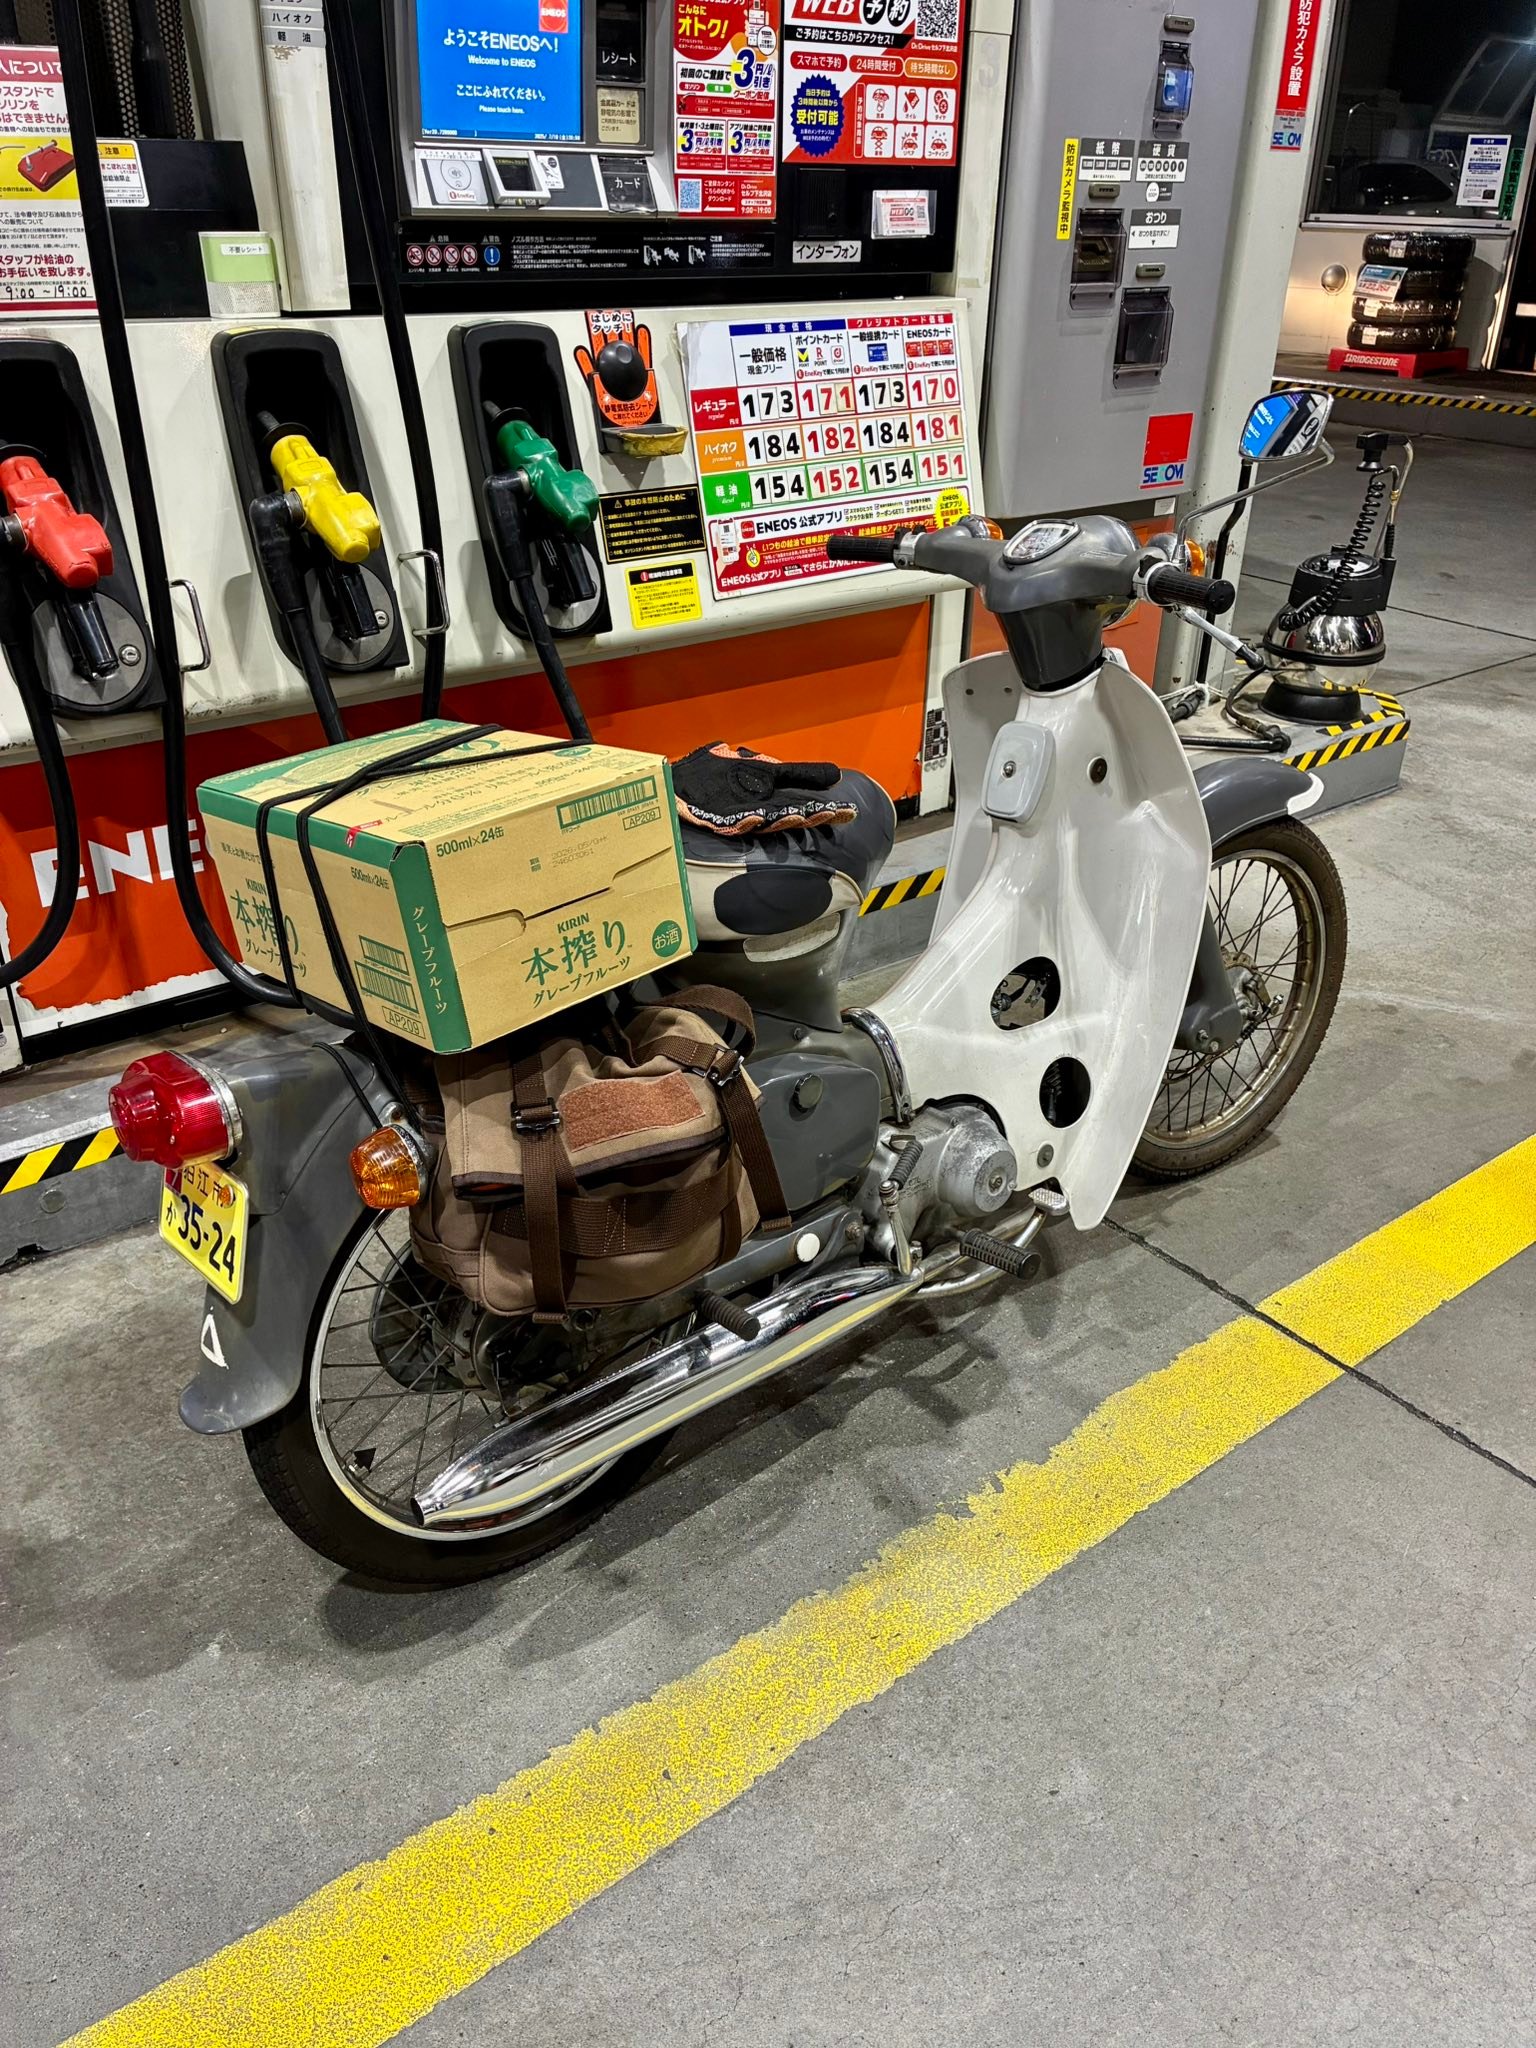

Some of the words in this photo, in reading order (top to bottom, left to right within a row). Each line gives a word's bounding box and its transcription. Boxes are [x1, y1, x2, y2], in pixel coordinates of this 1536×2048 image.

[272, 12, 312, 23] ハイオク
[678, 4, 707, 16] こんなに
[678, 16, 728, 39] オトク!
[795, 27, 895, 46] ご予約はこちらからアクセス!
[443, 28, 559, 53] ようこそENEOSへ!
[1288, 0, 1312, 97] 防犯カメラ設置
[468, 54, 500, 66] Welcome
[501, 57, 509, 67] to
[510, 57, 537, 68] ENEOS
[602, 50, 637, 67] レシート
[797, 55, 842, 69] スマホで予約
[856, 58, 896, 72] 24時間受付
[734, 48, 755, 88] 3
[910, 62, 951, 75] 待ち時間なし
[456, 84, 546, 102] ここにふれてください。
[796, 109, 839, 126] 受付可能
[1273, 132, 1302, 146] SECOM
[1095, 141, 1121, 156] 紙幣
[1152, 143, 1176, 158] 硬貨
[614, 176, 641, 190] カード
[1060, 143, 1076, 234] 防犯カメラ監視中
[1145, 211, 1167, 224] おつり
[796, 244, 859, 260] インターフォン
[591, 312, 632, 323] はじめに
[857, 314, 944, 328] クレジットカード価格
[592, 323, 631, 334] タッチ!
[764, 321, 812, 333] 現金価格
[795, 333, 843, 346] ポイントカード
[852, 330, 900, 342] 一般提携カード
[906, 327, 951, 339] ENEOSカード
[739, 346, 787, 363] 一般価格
[1344, 353, 1400, 367] BRIDGESTONE
[747, 363, 783, 376] 現金フリー
[694, 399, 736, 413] レギュラー
[743, 390, 794, 418] 173
[802, 386, 851, 412] 171
[858, 380, 905, 407] 173
[912, 377, 956, 402] 170
[704, 441, 737, 455] ハイオク
[748, 432, 800, 460] 184
[807, 426, 857, 453] 182
[863, 421, 910, 447] 184
[916, 414, 959, 441] 181
[715, 483, 738, 497] 軽油
[754, 473, 805, 500] 154
[813, 466, 860, 493] 152
[869, 458, 914, 486] 154
[921, 454, 963, 478] 151
[1143, 464, 1184, 484] SECOM
[940, 500, 962, 510] 公式アプリ
[756, 519, 797, 535] ENEOS
[799, 510, 842, 528] 公式アプリ
[629, 810, 657, 828] AP209
[436, 826, 504, 858] 500ml×24缶
[245, 877, 268, 897] KIRIN
[557, 912, 590, 934] KIRIN
[654, 927, 680, 951] お酒
[413, 905, 448, 1016] グレープフルーツ
[521, 919, 626, 986] 本搾り
[533, 956, 631, 1009] グレープフルーツ
[389, 1010, 421, 1036] AP209
[178, 1194, 236, 1283] 35-24
